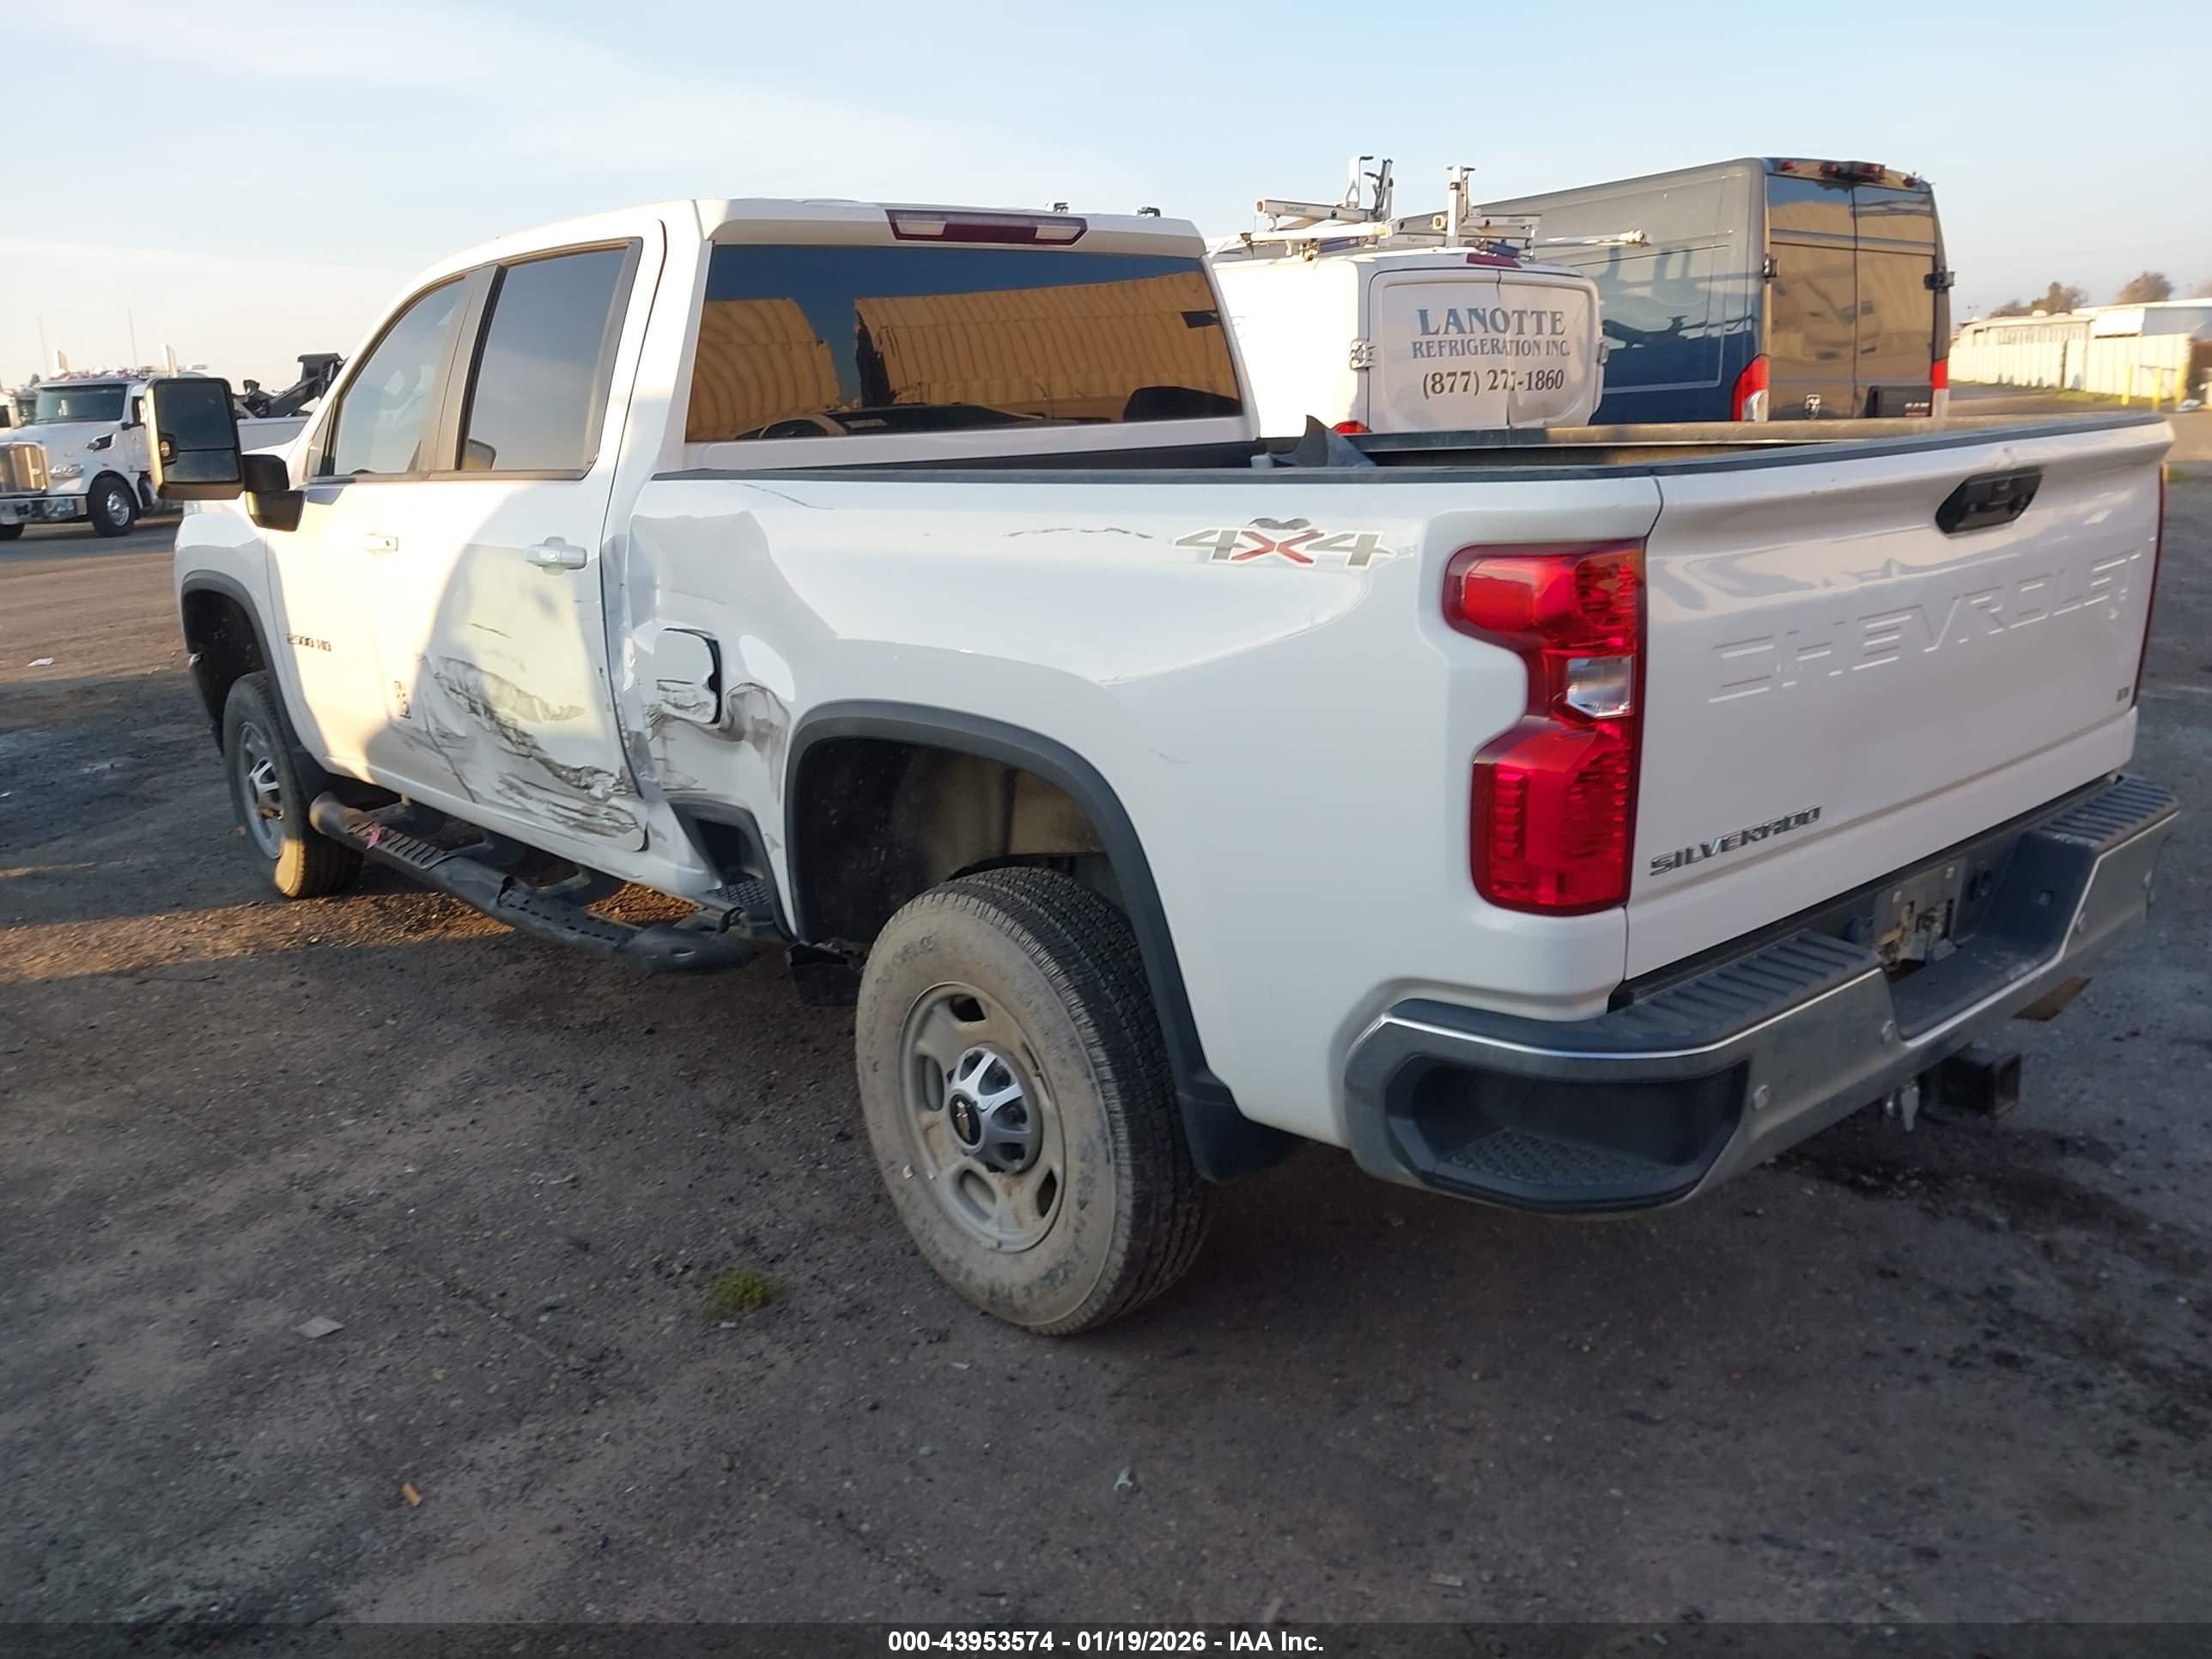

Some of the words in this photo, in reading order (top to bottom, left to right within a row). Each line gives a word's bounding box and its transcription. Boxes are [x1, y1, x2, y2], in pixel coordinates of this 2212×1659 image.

[1416, 307, 1567, 336] LANOTTE
[1412, 338, 1541, 358] REFRIGERATION
[1546, 340, 1571, 356] INC.
[1422, 370, 1480, 399] (877)
[1708, 548, 2142, 705] CHEVROLET
[1650, 805, 1822, 877] SILVERADO
